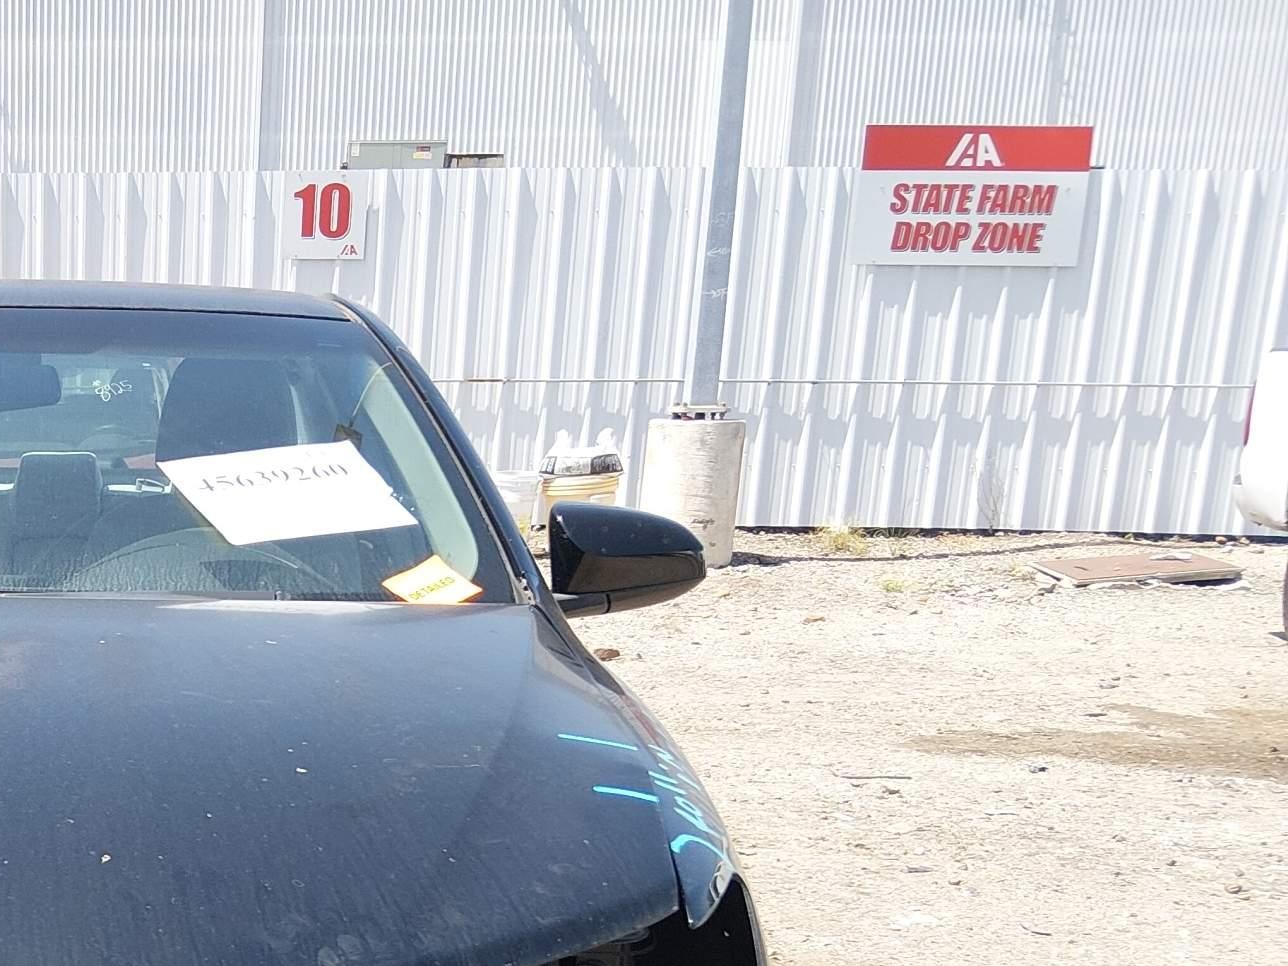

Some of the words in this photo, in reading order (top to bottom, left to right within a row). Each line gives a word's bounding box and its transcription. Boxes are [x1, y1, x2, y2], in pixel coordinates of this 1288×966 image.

[294, 182, 352, 240] 10
[890, 183, 975, 215] STATE
[976, 184, 1058, 216] FARM
[890, 221, 971, 252] DROP
[972, 222, 1047, 254] ZONE
